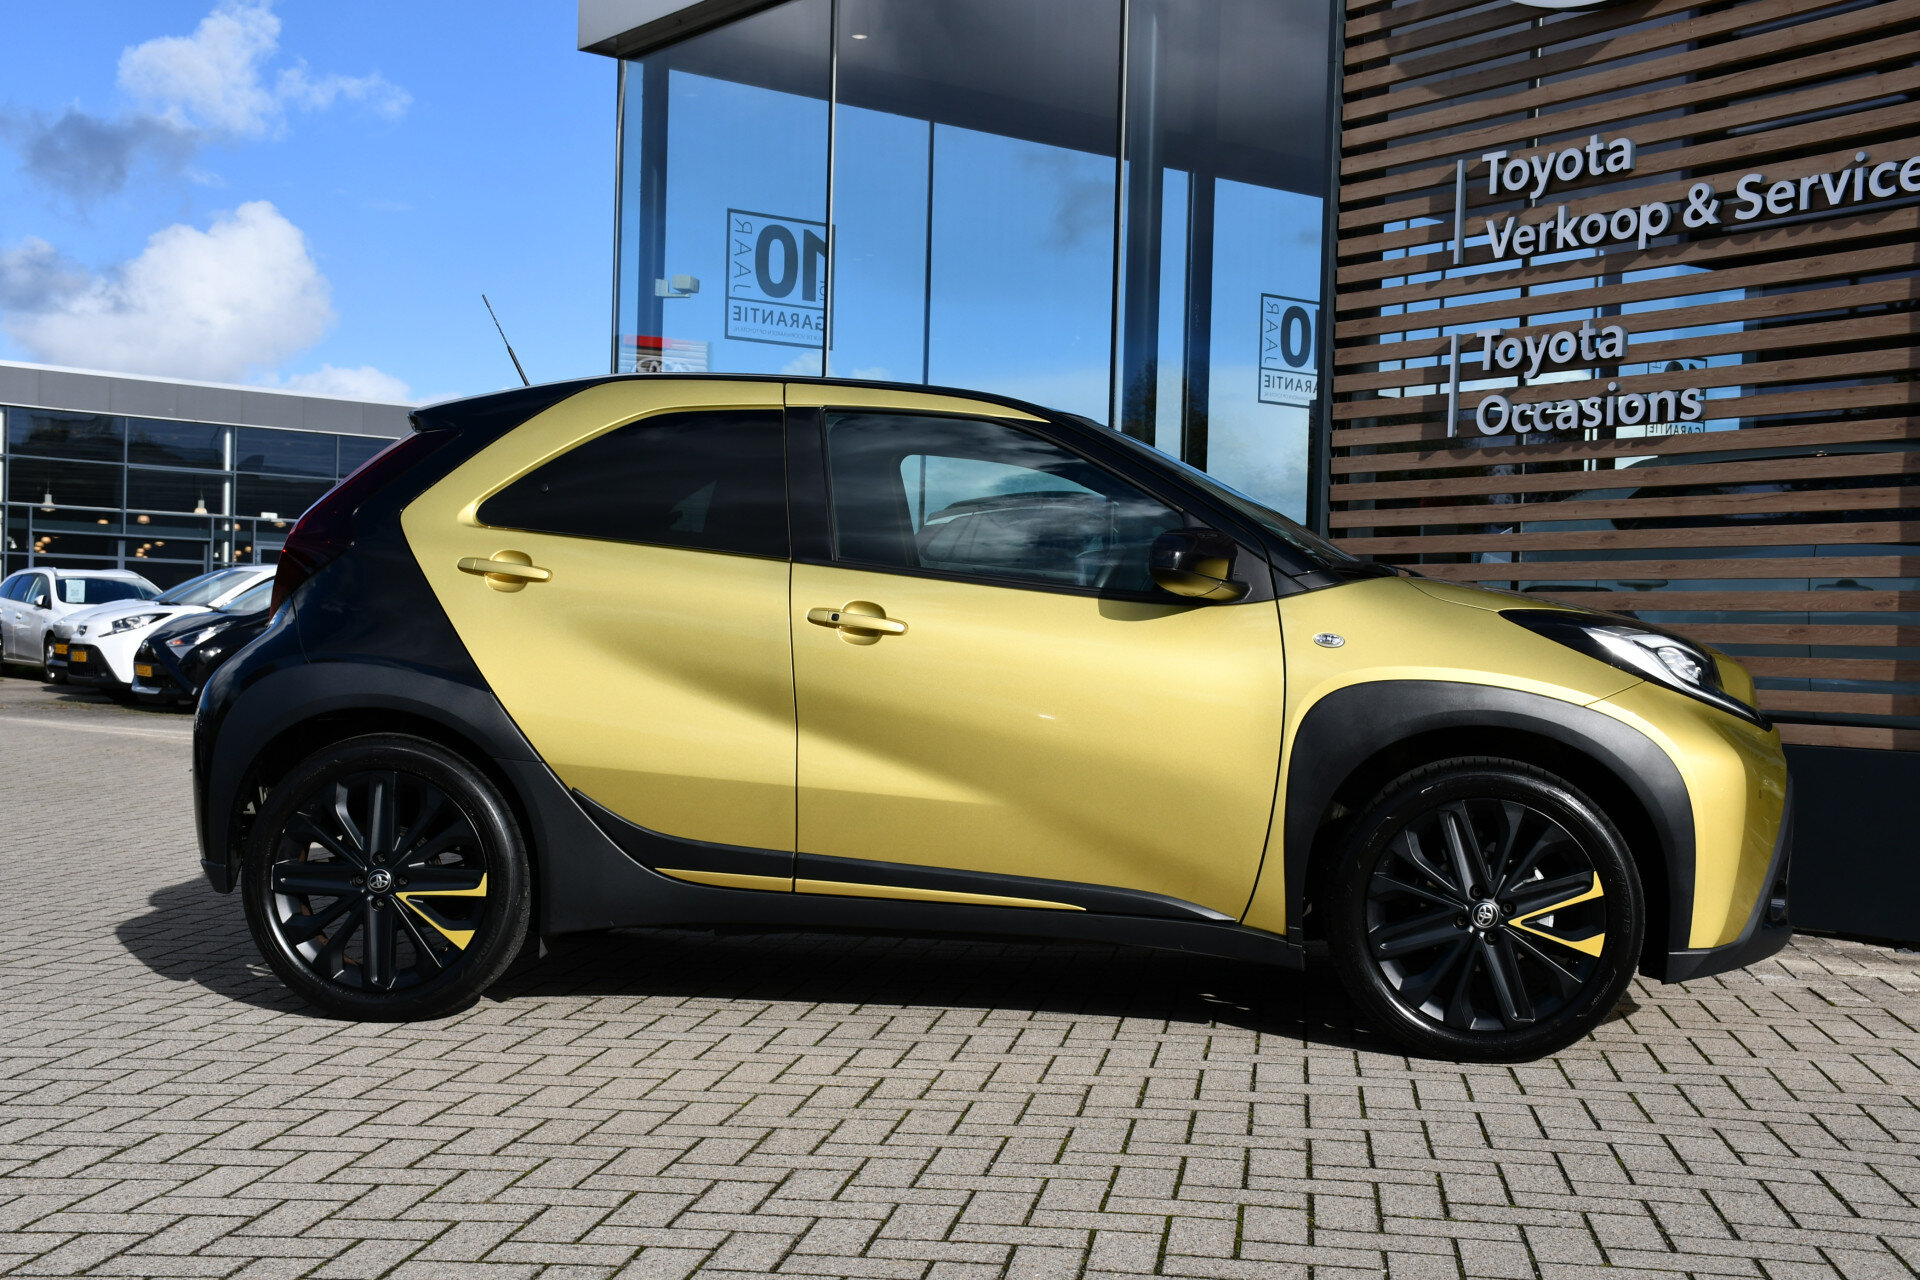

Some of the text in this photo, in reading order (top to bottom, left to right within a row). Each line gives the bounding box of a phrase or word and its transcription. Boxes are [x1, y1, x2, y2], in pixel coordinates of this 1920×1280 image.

[1482, 134, 1634, 199] Toyota
[1486, 151, 1920, 259] Verkoop & Service
[1476, 319, 1627, 379] Toyota
[1476, 381, 1703, 435] Occasions
